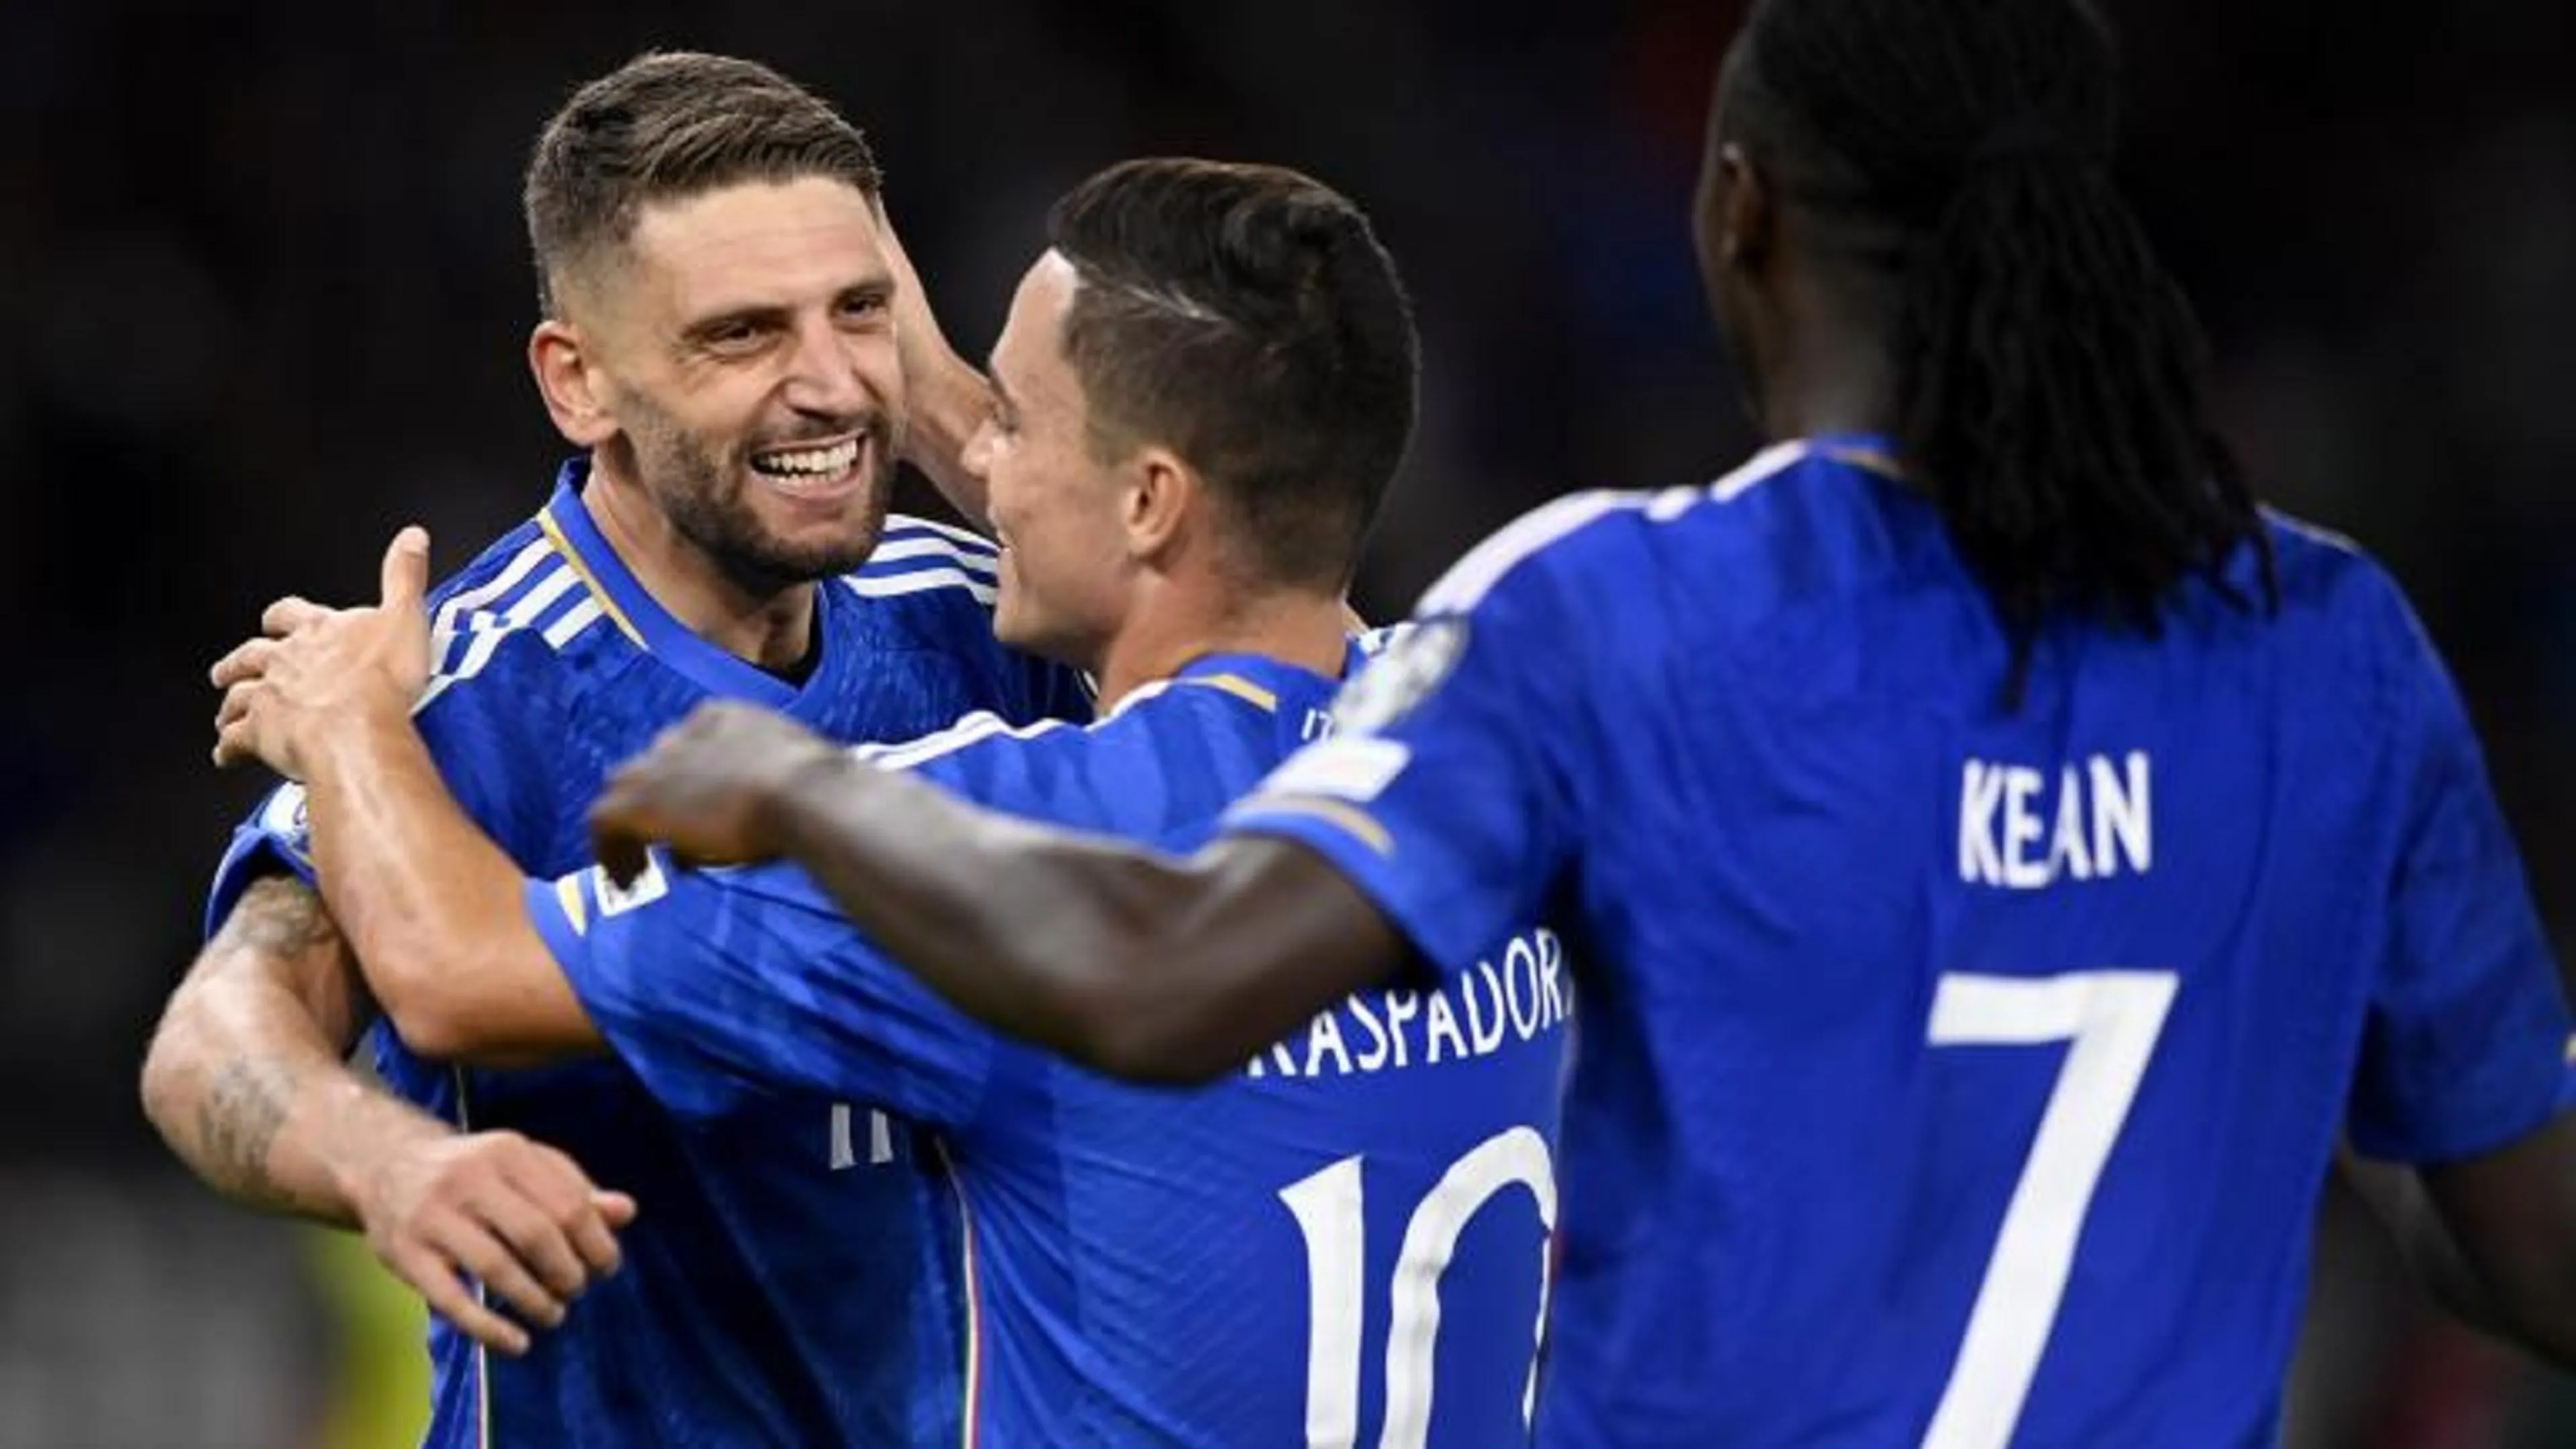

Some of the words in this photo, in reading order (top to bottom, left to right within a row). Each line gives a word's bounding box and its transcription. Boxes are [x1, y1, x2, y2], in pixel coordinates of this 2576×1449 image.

[1959, 749, 2150, 888] KEAN
[1278, 1125, 1557, 1449] 10
[1920, 969, 2180, 1449] 7
